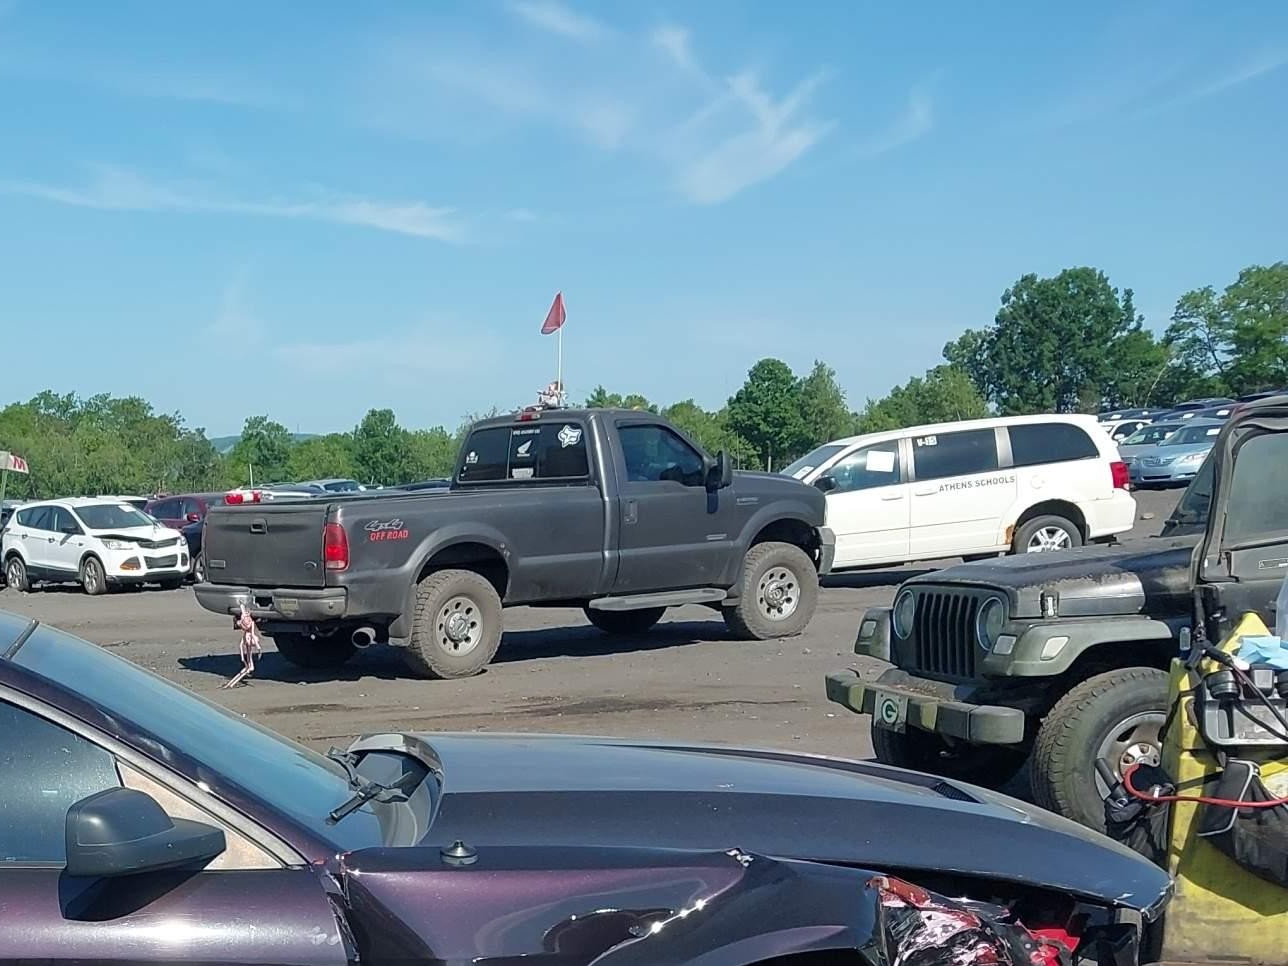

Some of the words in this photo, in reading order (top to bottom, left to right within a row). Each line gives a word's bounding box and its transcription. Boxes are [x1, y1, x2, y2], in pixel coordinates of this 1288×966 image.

[939, 482, 973, 492] ATHENS
[975, 476, 1015, 487] SCHOOLS
[370, 532, 386, 541] OFF
[387, 530, 409, 539] ROAD
